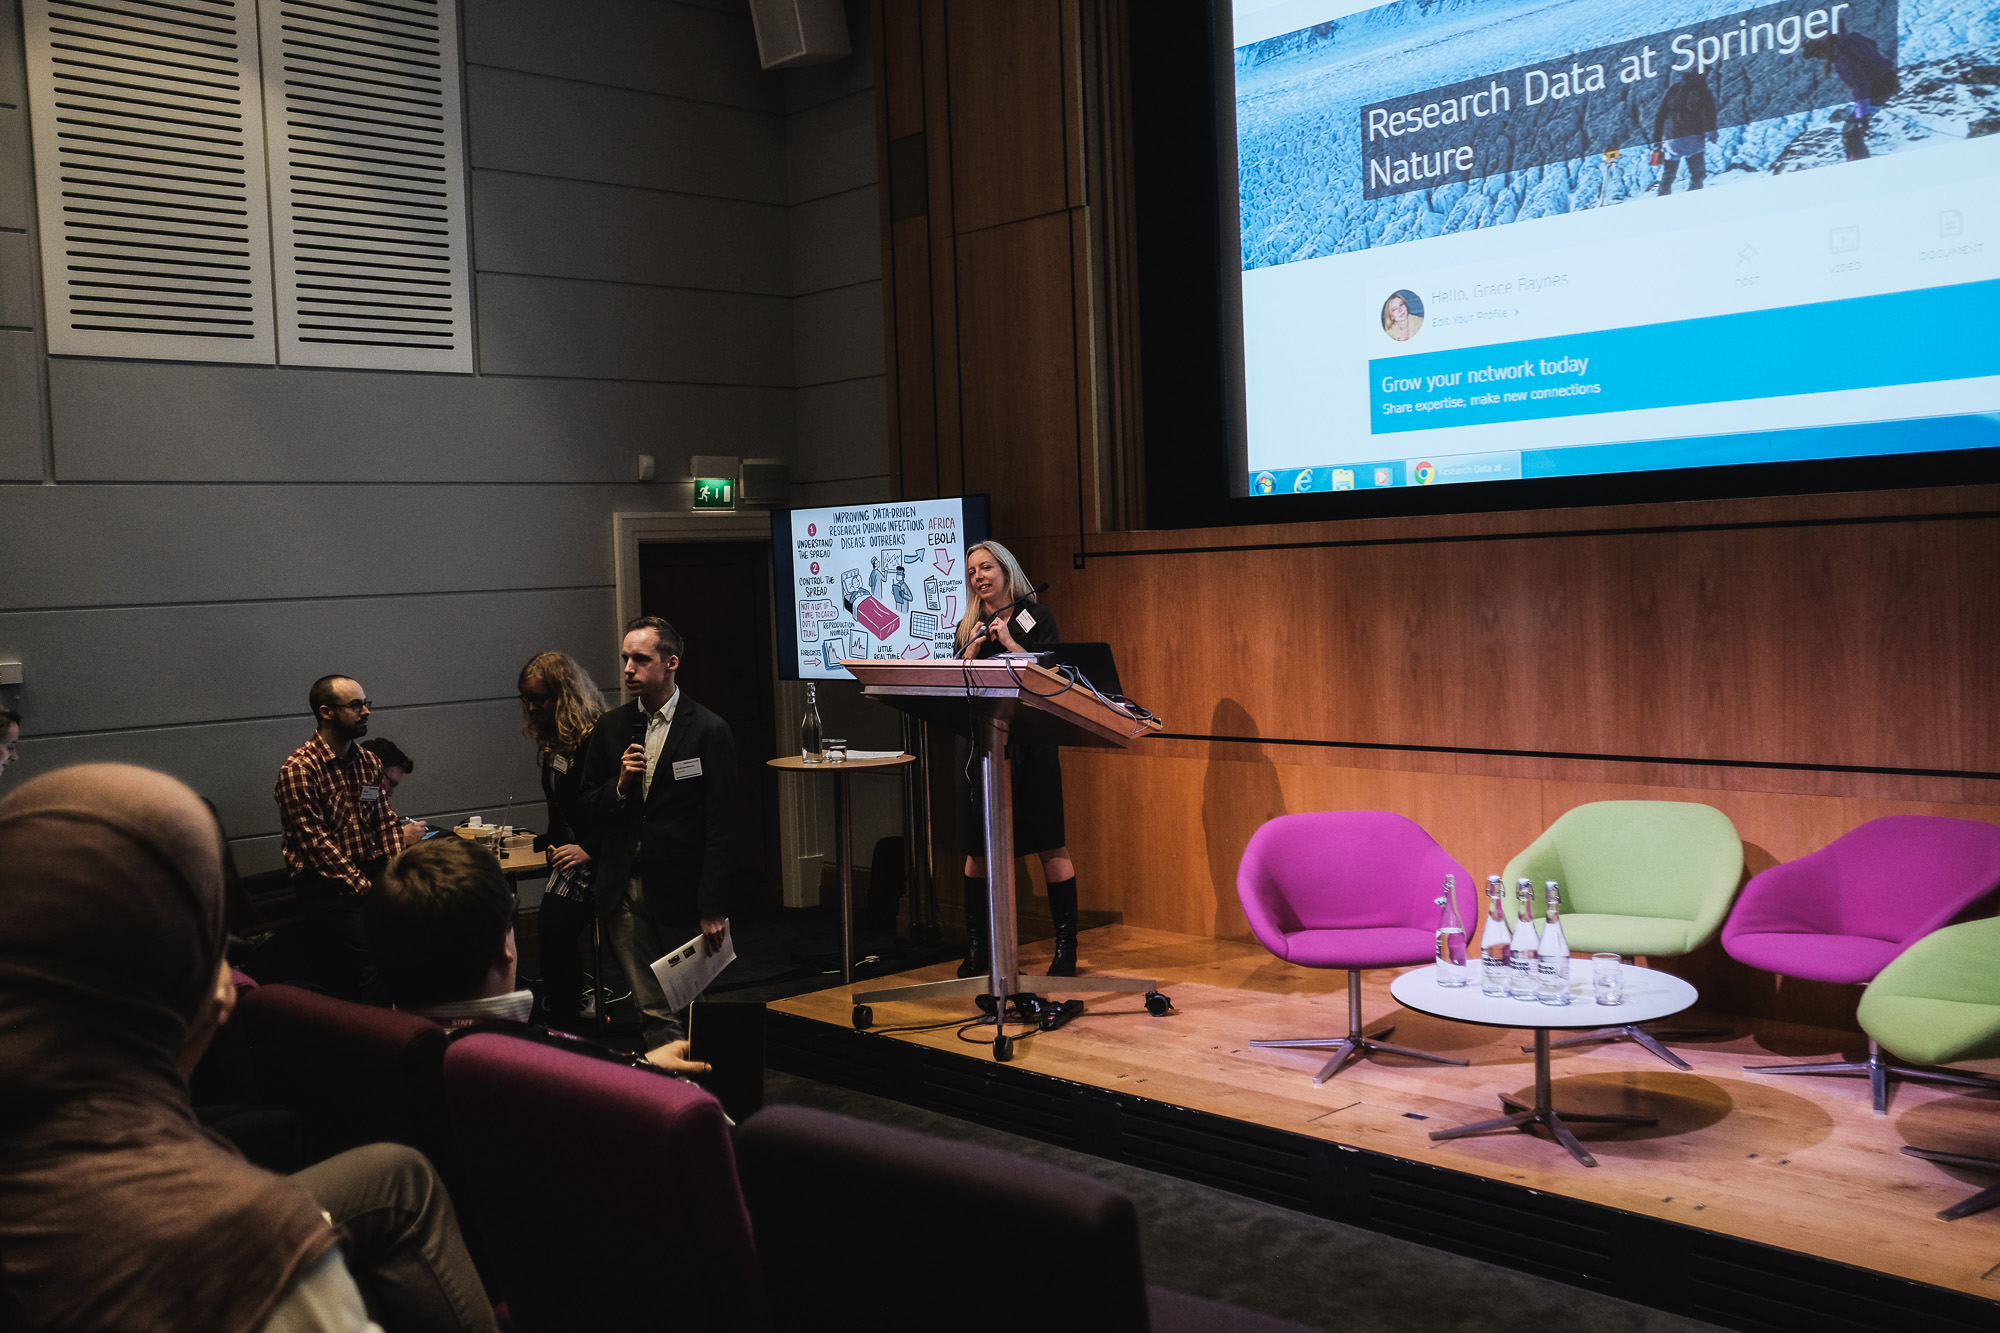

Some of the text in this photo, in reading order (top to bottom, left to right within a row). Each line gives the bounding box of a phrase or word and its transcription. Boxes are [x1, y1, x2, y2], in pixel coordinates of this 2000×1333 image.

[1367, 2, 1849, 142] Research Data at Springer
[1369, 144, 1474, 189] Nature
[1473, 281, 1513, 299] Grace
[1518, 274, 1569, 293] Baynes
[1432, 308, 1509, 328] Edit Your Profile
[1382, 355, 1590, 393] Grow your network today
[1382, 383, 1602, 415] Share expertise, make new connections
[1473, 464, 1493, 474] Data
[833, 506, 917, 524] IMPROVING DATA-DRIVEN
[829, 518, 925, 537] RESEARCH DURING INFECTIOUS
[928, 517, 956, 531] AFRICA
[797, 538, 833, 549] UNDERSTAND
[841, 533, 906, 550] DISEASE OUTBREAKS
[928, 532, 957, 546] EBOLA
[798, 549, 831, 560] THE SPREAD
[799, 575, 835, 587] CONTROL THE
[805, 586, 828, 598] SPREAD
[939, 586, 958, 594] REPORT
[801, 602, 810, 610] NOT
[823, 601, 830, 609] OF
[802, 611, 814, 619] TIME
[821, 610, 836, 618] CARRY
[802, 620, 816, 628] OUT A
[823, 621, 855, 630] REPRODUCTION
[830, 629, 850, 637] NUMBER
[934, 632, 956, 641] PATIENT
[877, 645, 893, 653] LITTLE
[934, 642, 955, 650] DATABA
[800, 649, 822, 657] FORECASTS
